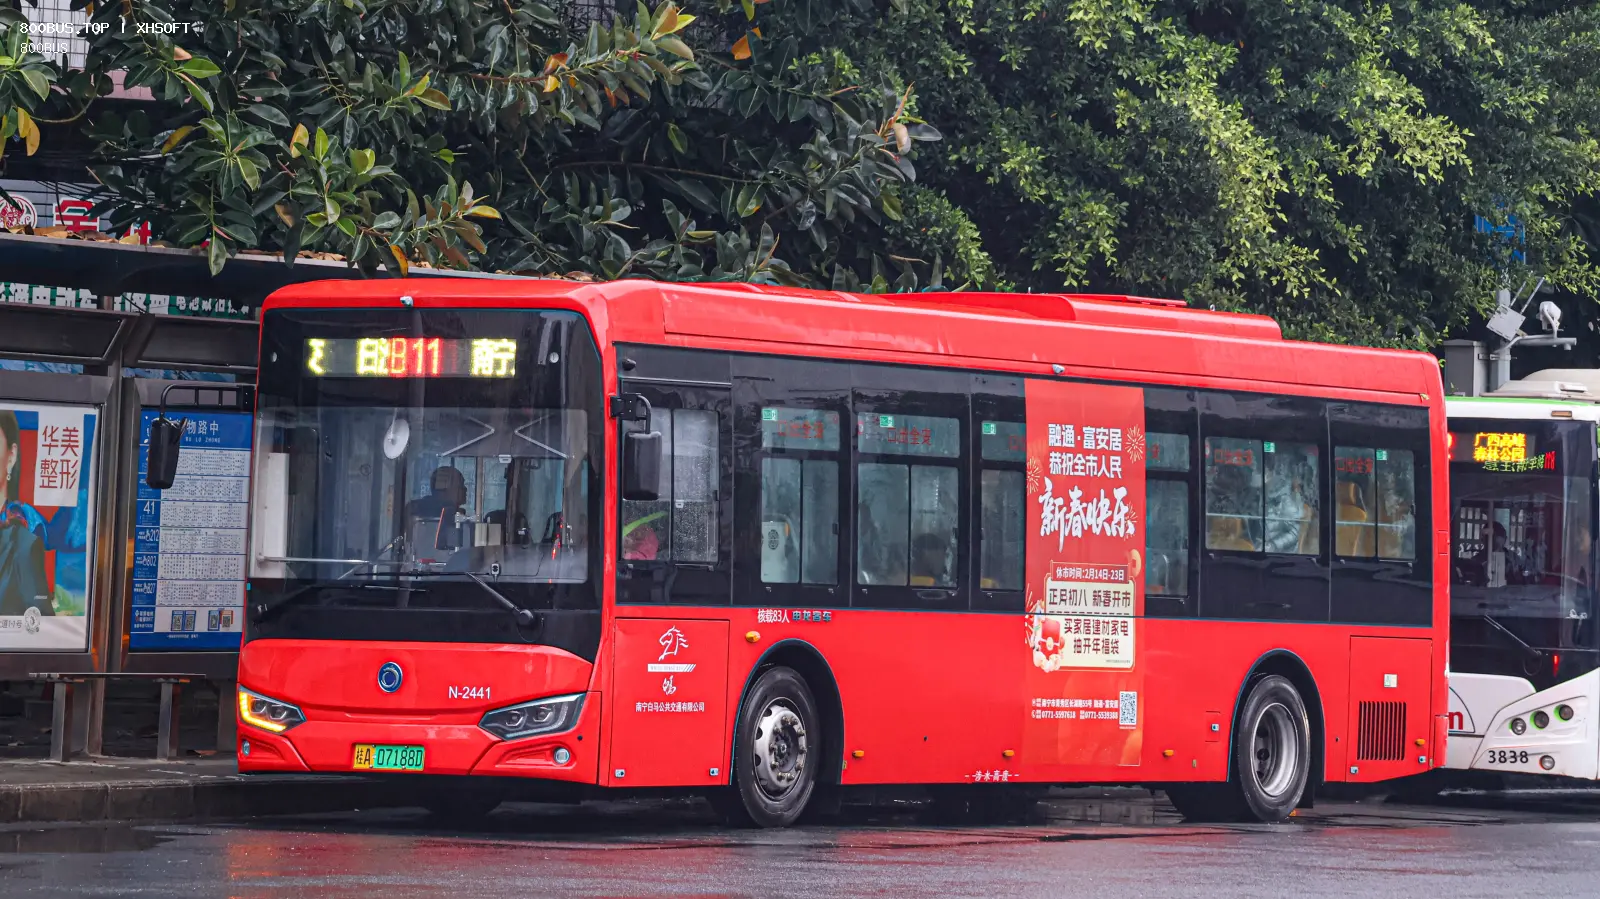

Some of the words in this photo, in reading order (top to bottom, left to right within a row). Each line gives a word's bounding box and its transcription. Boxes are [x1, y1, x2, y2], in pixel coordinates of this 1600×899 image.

[41, 425, 80, 457] 华美
[1047, 423, 1123, 452] 融通·富安居
[1473, 447, 1526, 462] 森林公园
[39, 458, 78, 490] 整形
[1048, 451, 1123, 479] 恭祝全市人民
[143, 500, 155, 515] 41
[1038, 475, 1136, 554] 新春快乐
[1048, 588, 1088, 607] 正月初八
[1092, 589, 1131, 608] 新春开市
[757, 608, 791, 624] 核载83人
[1064, 618, 1129, 637] 买家居建材家电
[1073, 637, 1120, 655] 抽开年福袋
[448, 686, 491, 700] N-2441
[635, 701, 705, 713] 南宁白马公共交通有限公司
[376, 748, 424, 767] 07188D
[1488, 750, 1529, 764] 3838
